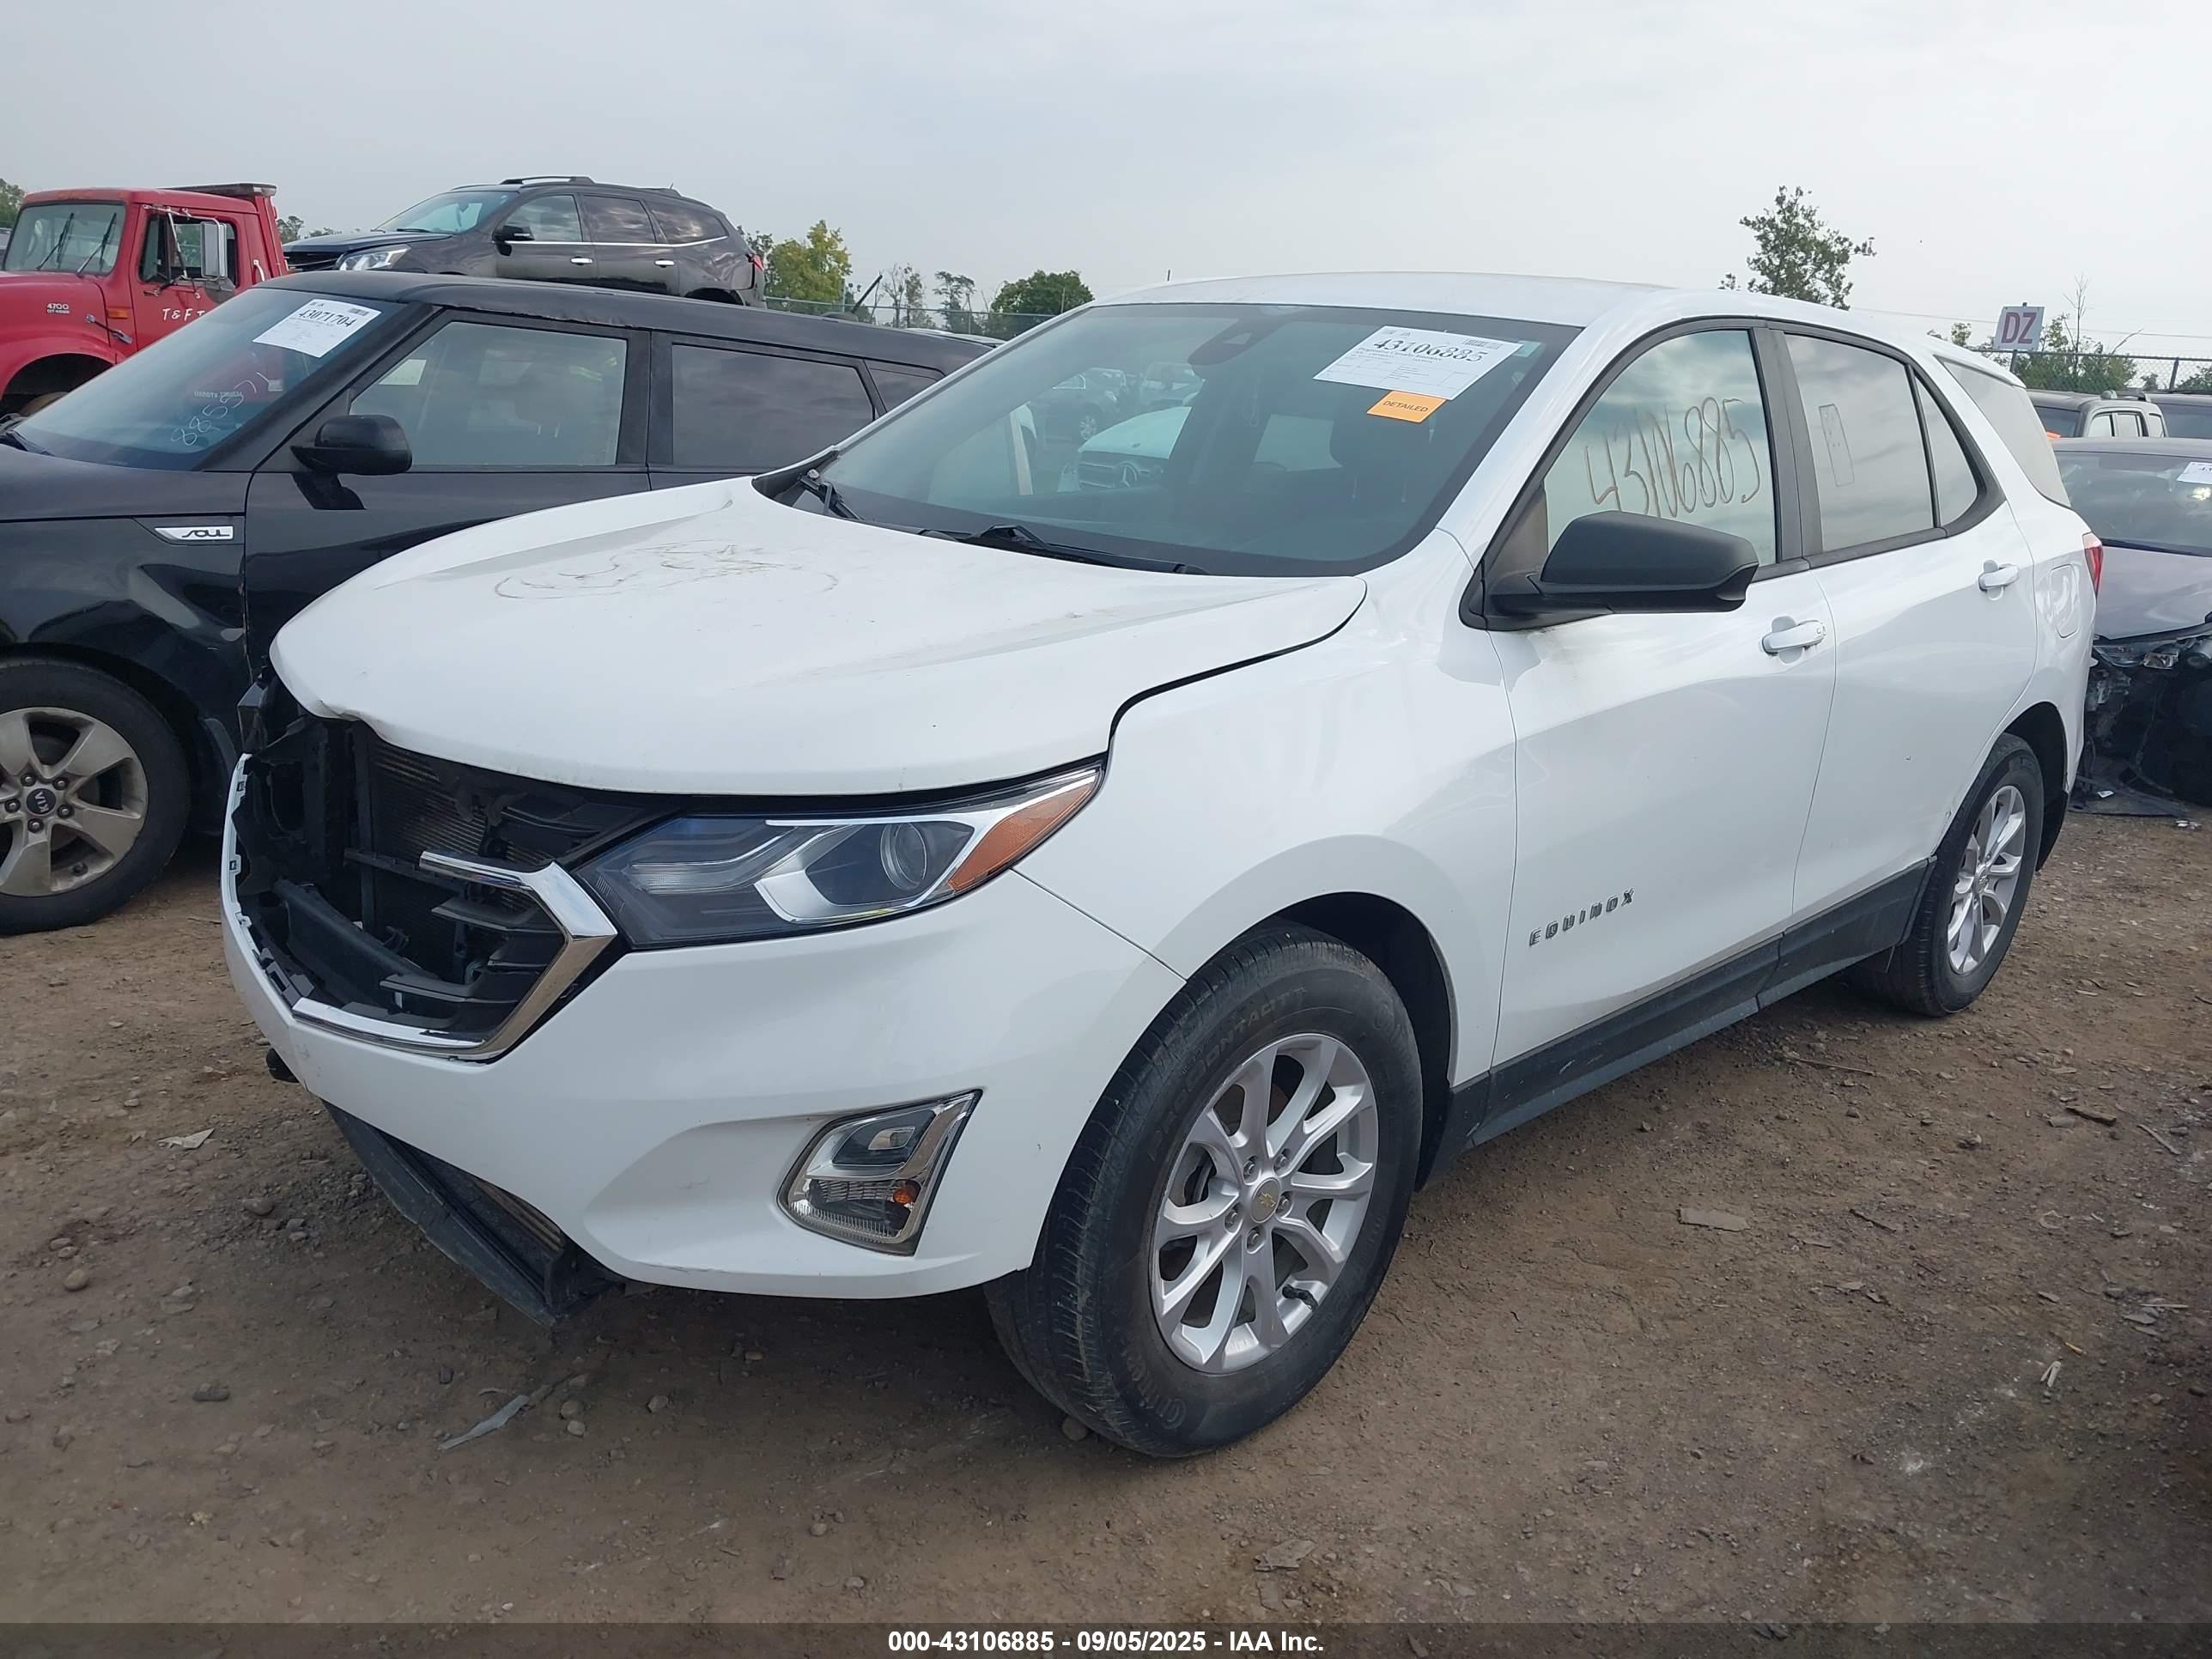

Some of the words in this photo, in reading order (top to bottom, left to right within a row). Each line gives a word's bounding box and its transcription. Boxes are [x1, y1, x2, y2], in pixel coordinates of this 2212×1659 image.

[298, 308, 357, 328] 43071704
[2001, 312, 2037, 344] DZ
[1373, 338, 1490, 362] 43106885
[1382, 399, 1429, 413] DETAILED
[1584, 396, 1760, 519] 43106885
[181, 529, 230, 538] SOUL
[35, 791, 49, 812] KIA
[1528, 888, 1634, 946] EQUINOX
